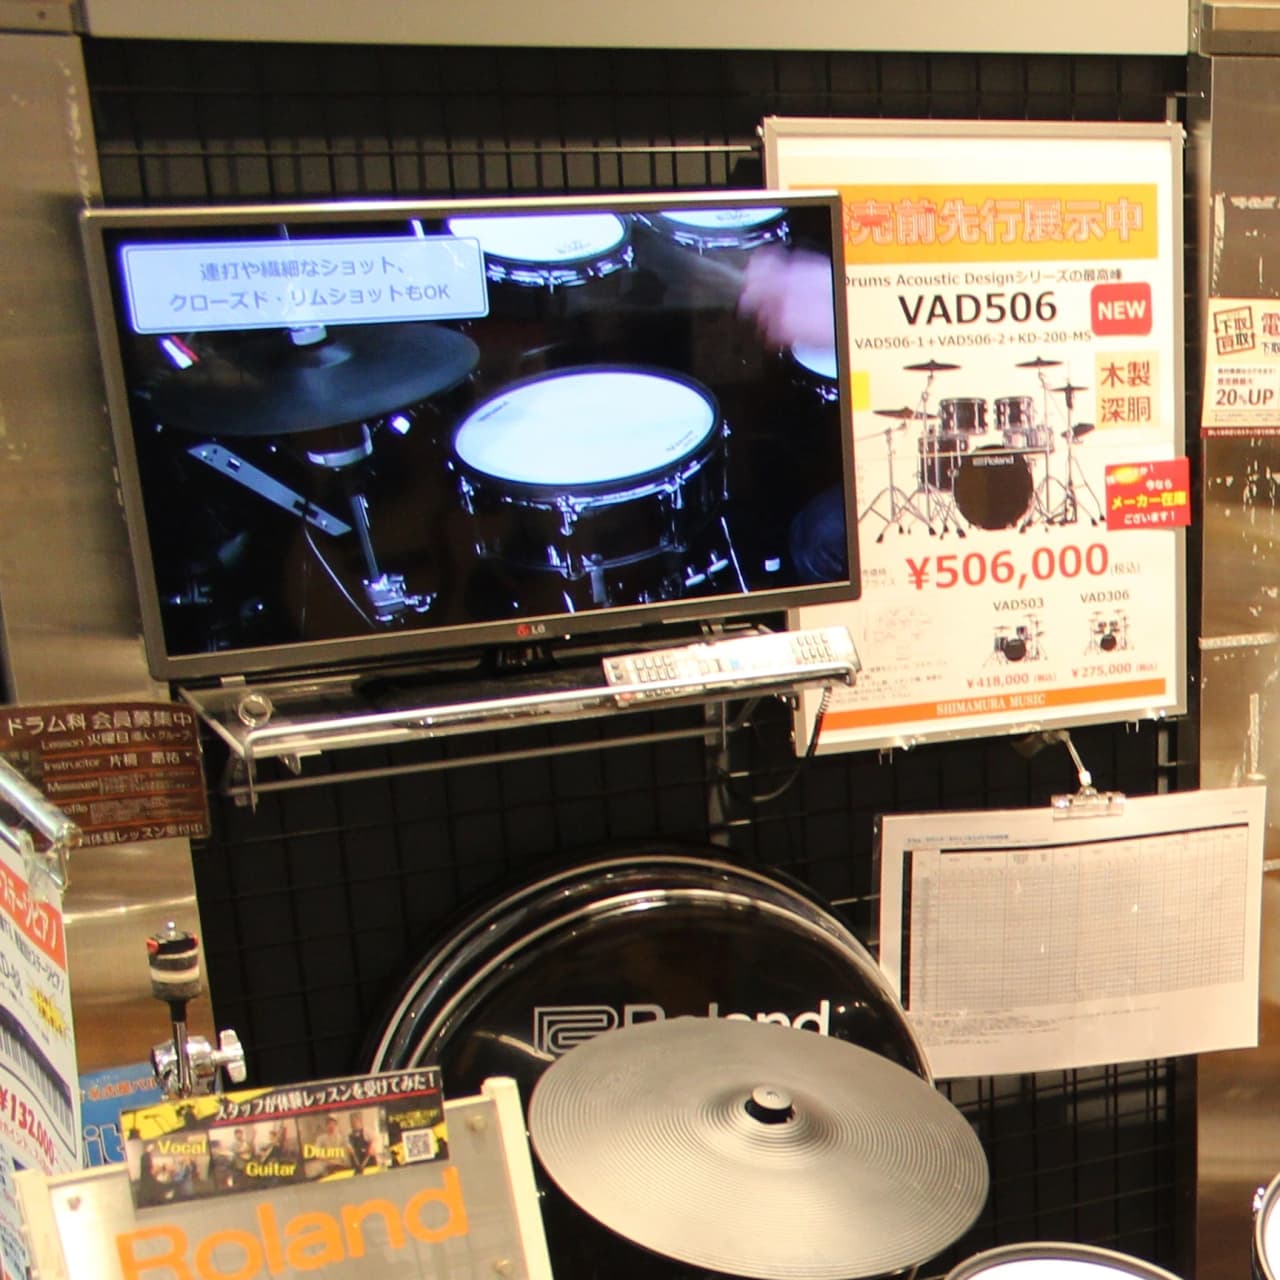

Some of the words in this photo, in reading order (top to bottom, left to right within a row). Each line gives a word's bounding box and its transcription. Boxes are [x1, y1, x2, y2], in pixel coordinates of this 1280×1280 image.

[844, 197, 1144, 246] 売前先行展示中
[896, 272, 959, 287] Acoustic
[169, 283, 449, 313] クローズド・リムショットもOK
[898, 291, 1057, 326] VAD506
[1097, 300, 1146, 321] NEW
[1100, 361, 1151, 387] 木製
[1100, 396, 1151, 422] 深胴
[1146, 478, 1173, 489] 今なら
[1111, 492, 1186, 510] メーカー在庫
[905, 543, 1109, 591] ¥506,000
[993, 597, 1045, 612] VAD503
[1080, 589, 1131, 604] VAD306
[1071, 661, 1132, 679] ¥275,000
[967, 671, 1030, 689] ¥418,000
[936, 695, 1007, 717] SHIMAMURA
[1009, 693, 1046, 711] MUSIC
[8, 712, 86, 736] ドラム科
[92, 710, 192, 730] 会員募集中
[88, 731, 129, 745] 火曜日
[43, 759, 100, 771] Instructor
[82, 823, 203, 847] 料体験レッスン受付中
[215, 1074, 436, 1122] スタッフが体験レッスンを受けてみた!
[158, 1140, 207, 1155] Vocal
[303, 1143, 346, 1159] Drum
[246, 1161, 297, 1177] Guitar
